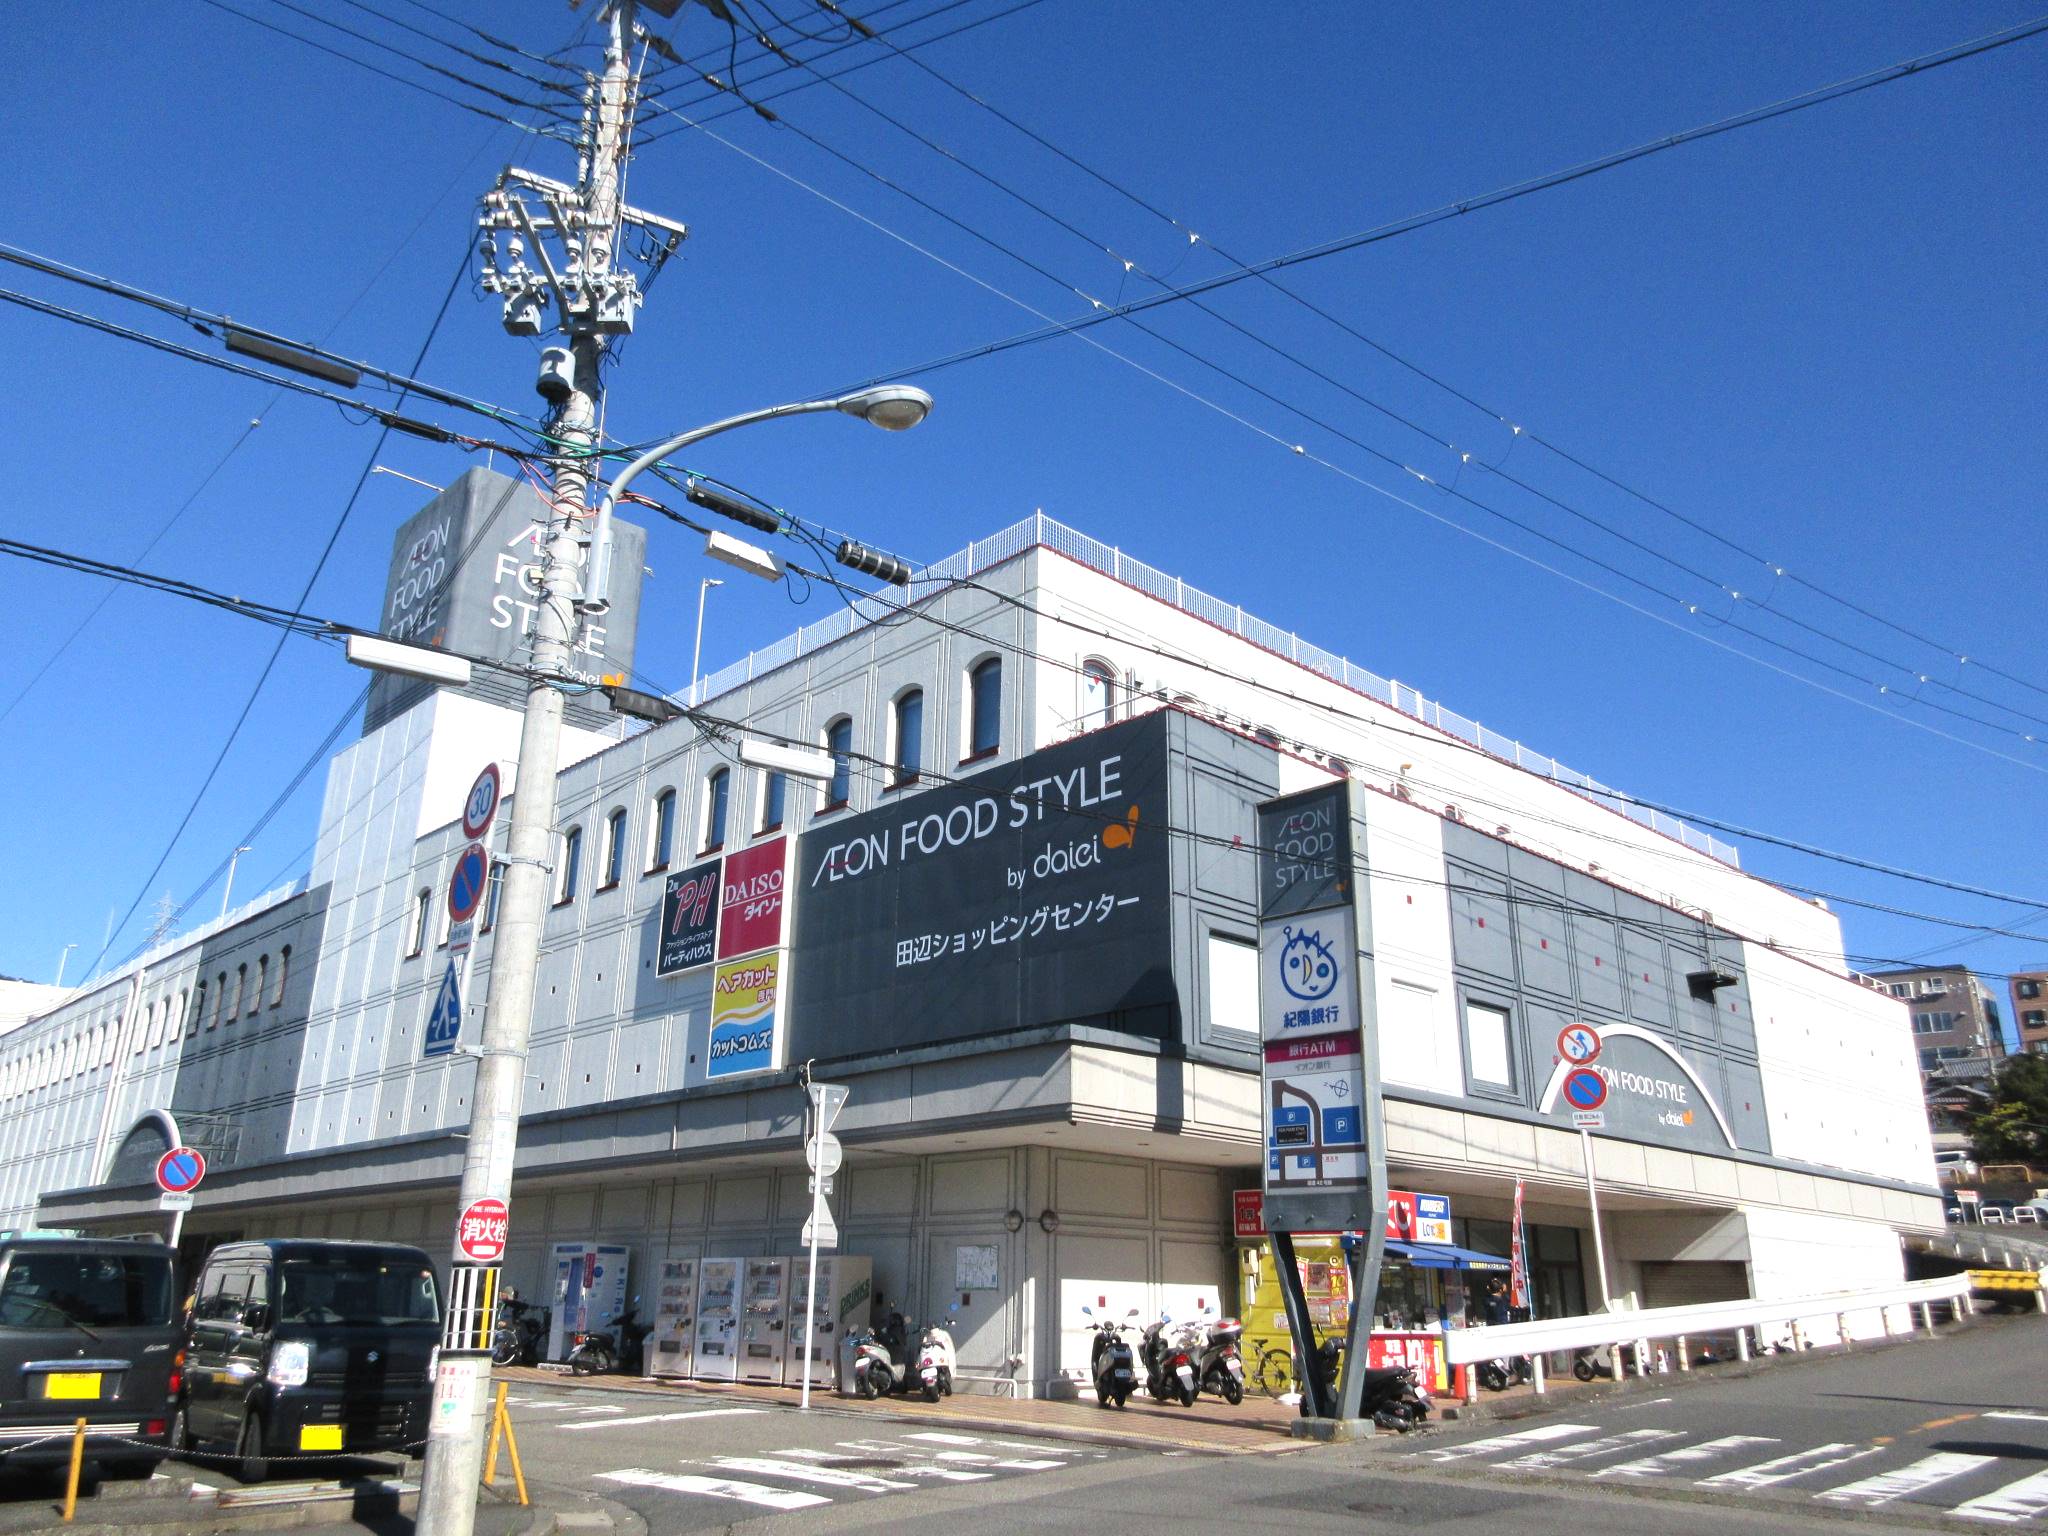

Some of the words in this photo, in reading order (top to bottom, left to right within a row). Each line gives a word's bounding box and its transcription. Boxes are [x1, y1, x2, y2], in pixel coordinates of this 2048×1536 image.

[391, 557, 446, 619] FOOD
[489, 594, 608, 659] STE
[469, 782, 492, 819] 30
[900, 797, 998, 861] FOOD
[1009, 755, 1122, 828] STYLE
[1007, 867, 1026, 889] by
[1033, 835, 1101, 878] daiei
[1274, 832, 1335, 863] FOOD
[723, 869, 783, 906] DAISO
[1275, 858, 1337, 889] STYLE
[672, 872, 716, 935] PH
[744, 898, 782, 922] ダイソー
[896, 893, 1140, 967] 田辺ショッピングセンター
[717, 963, 776, 993] ヘアカット
[757, 987, 777, 1003] 専門
[1283, 1005, 1340, 1029] 紀陽銀行
[1288, 1040, 1337, 1058] 銀行ATM
[1620, 1071, 1654, 1096] FOOD
[1655, 1079, 1687, 1104] STYLE
[462, 1218, 507, 1243] 消火栓
